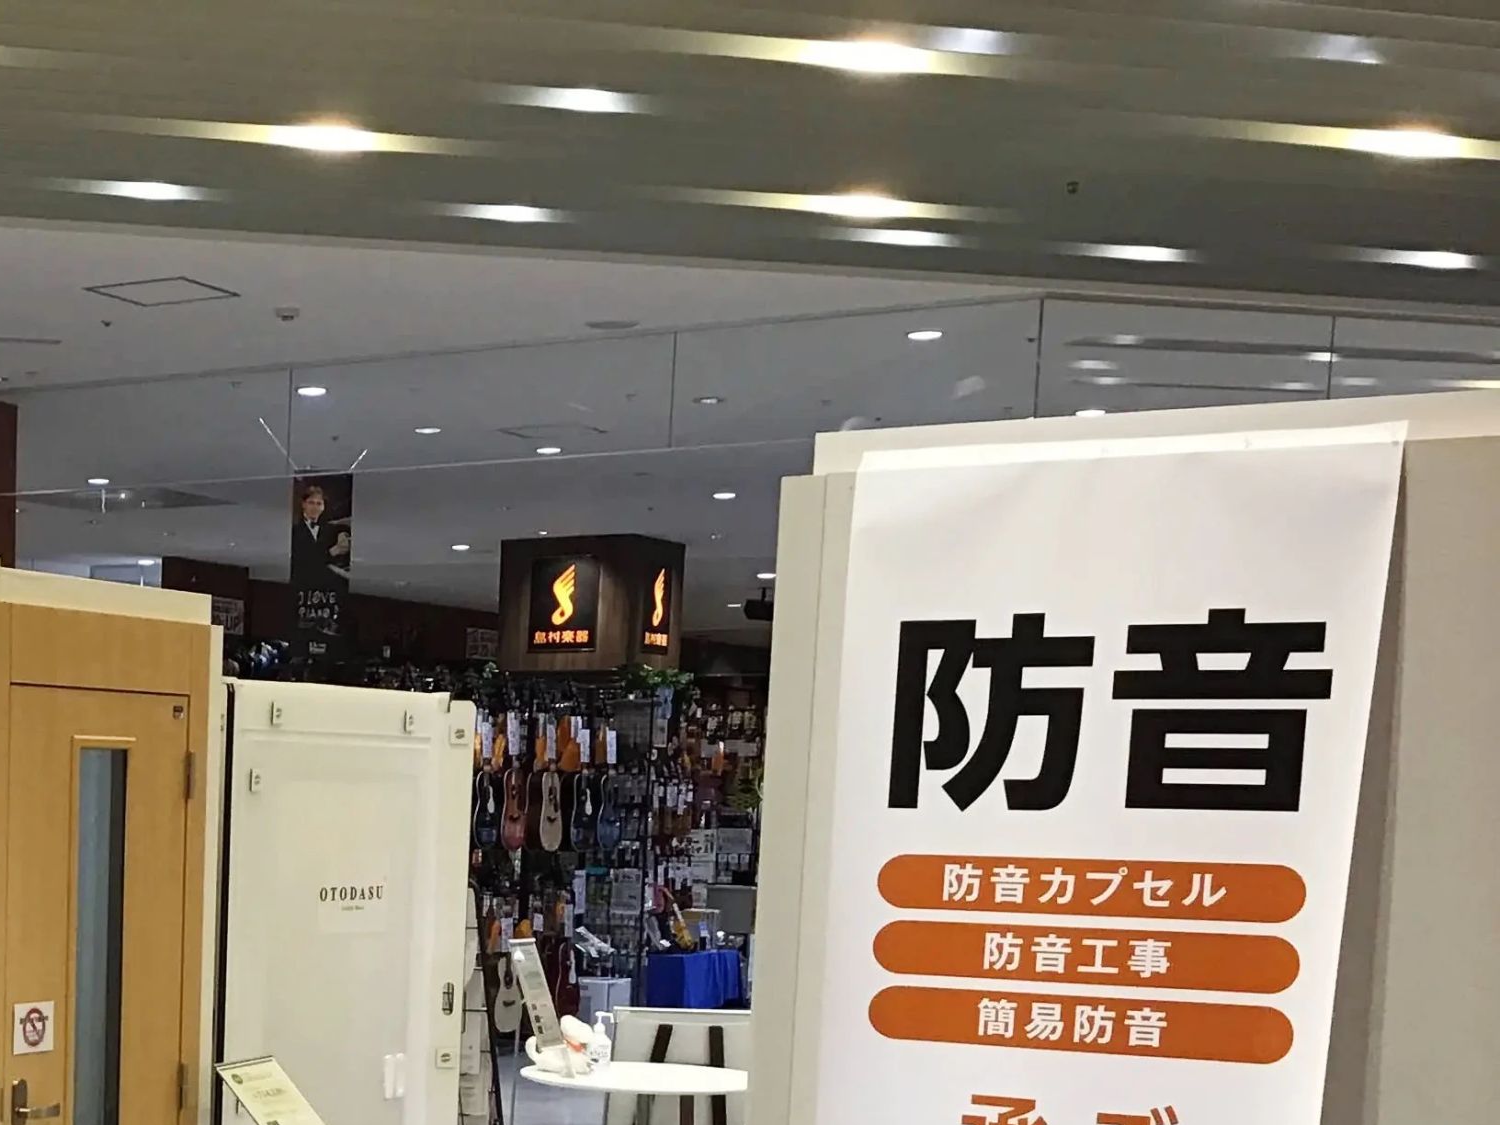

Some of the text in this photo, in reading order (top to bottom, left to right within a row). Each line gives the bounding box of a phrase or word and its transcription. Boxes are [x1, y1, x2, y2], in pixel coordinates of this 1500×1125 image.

[307, 590, 337, 605] LOVE
[534, 630, 589, 644] 島村楽器
[887, 608, 1333, 812] 防音
[320, 885, 384, 902] OTODASU
[942, 864, 1227, 908] 防音カプセル
[982, 932, 1173, 977] 防音工事
[977, 998, 1168, 1048] 簡易防音
